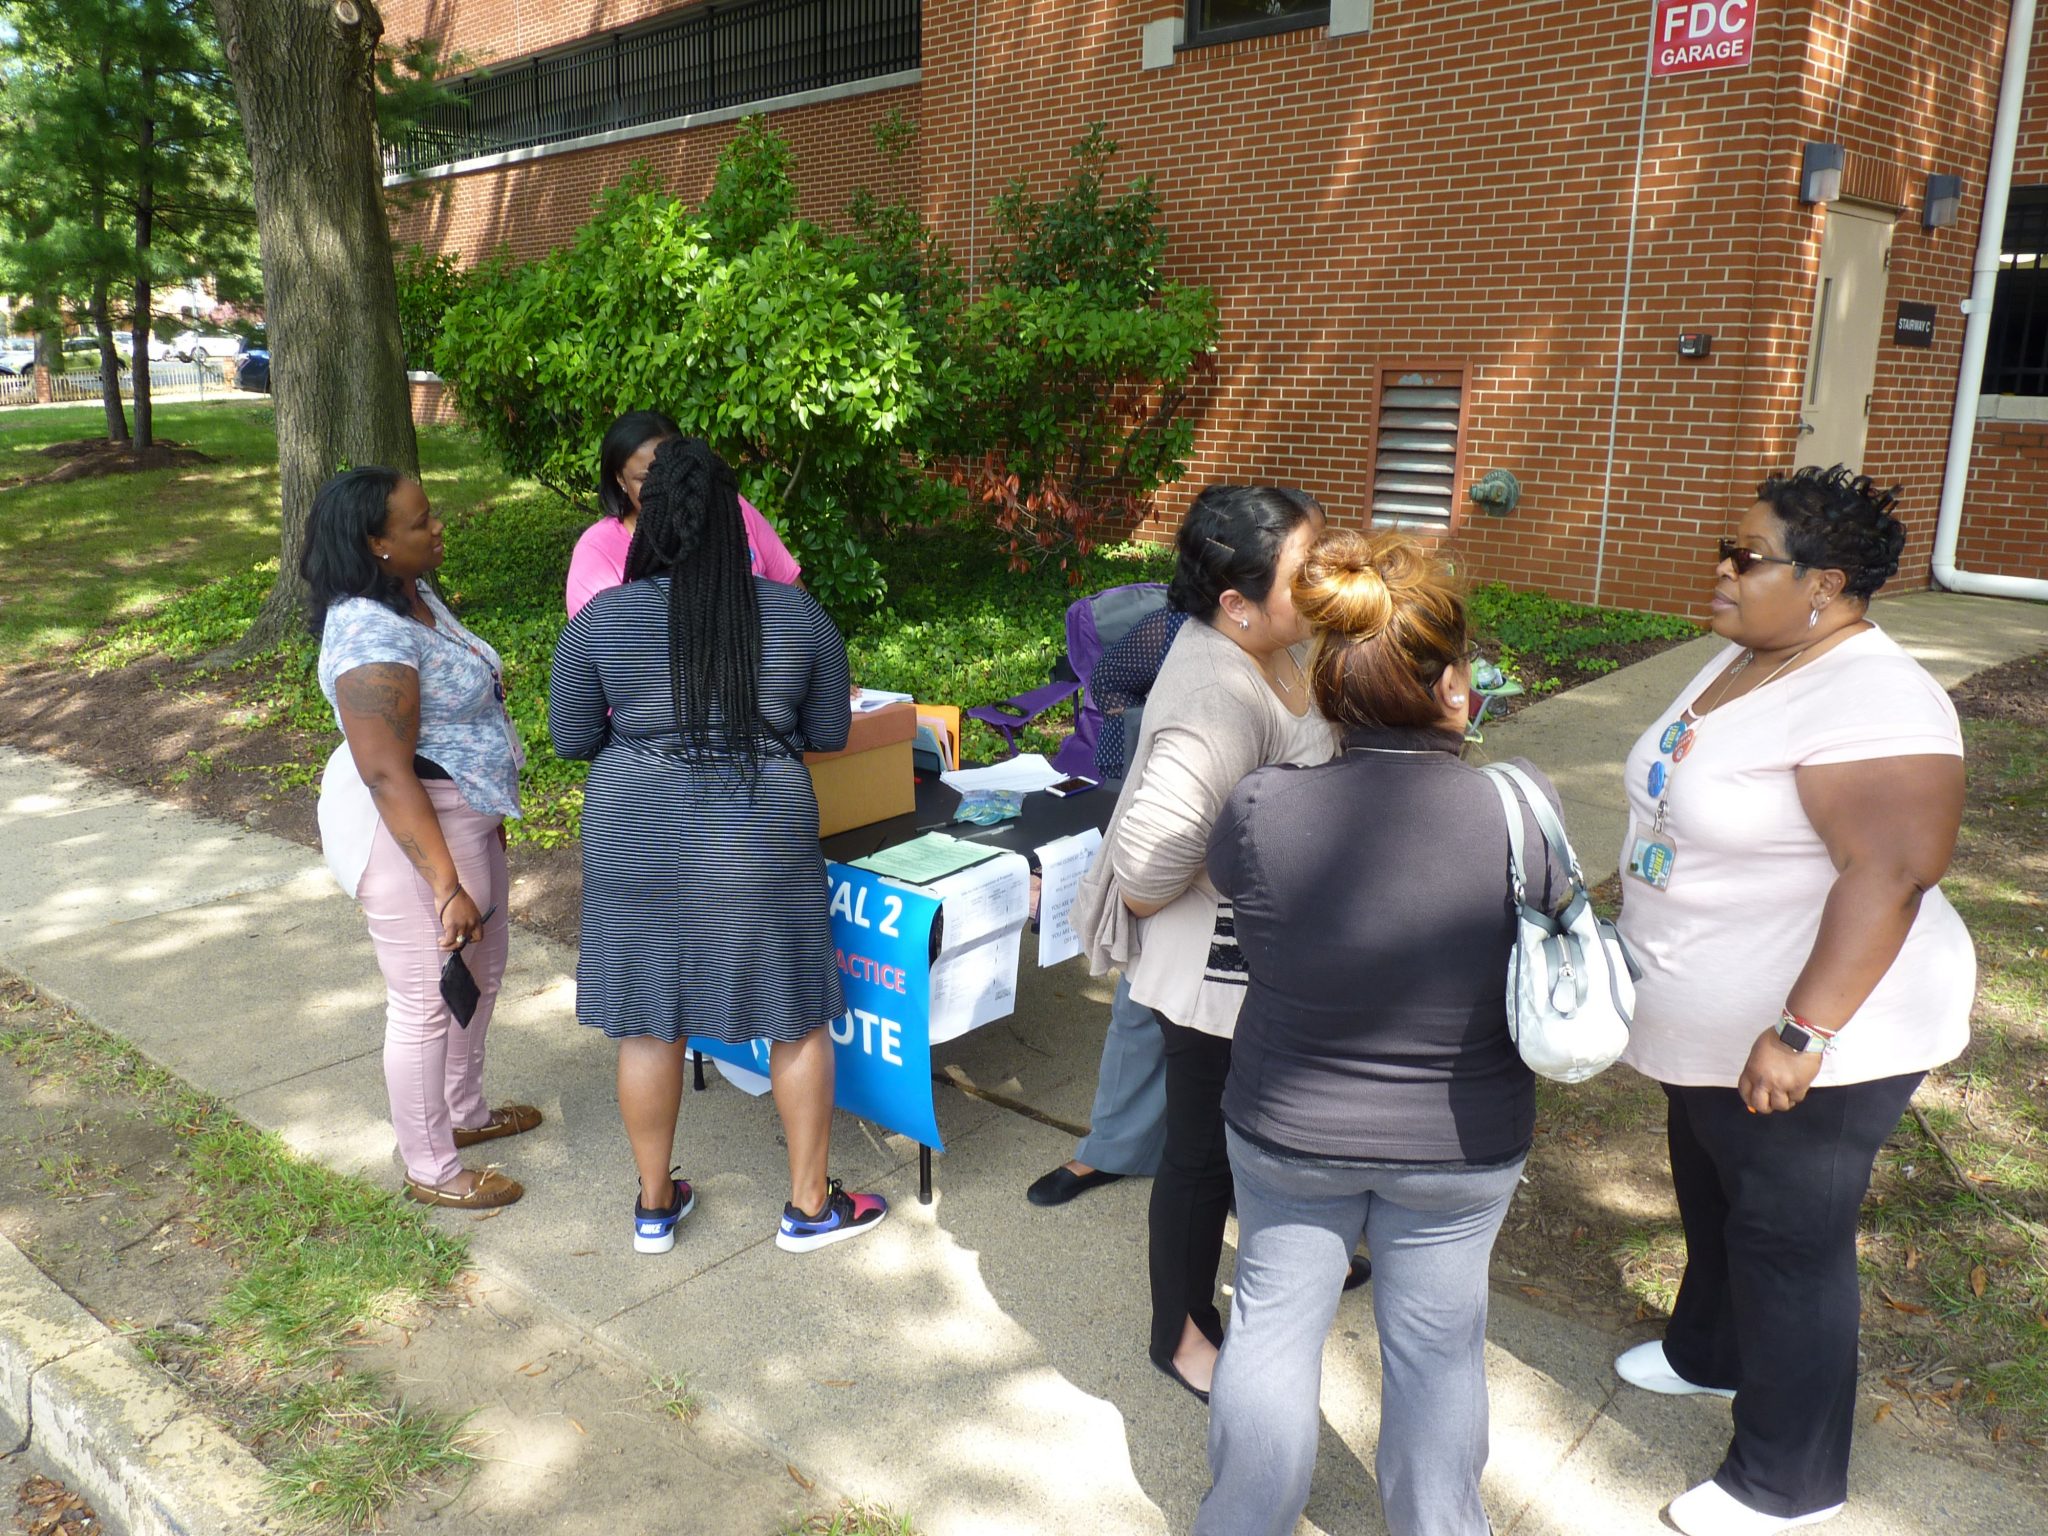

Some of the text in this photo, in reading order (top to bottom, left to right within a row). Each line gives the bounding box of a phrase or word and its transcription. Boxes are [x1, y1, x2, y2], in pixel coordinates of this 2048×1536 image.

[1664, 0, 1747, 42] FDC
[1661, 39, 1744, 66] GARAGE
[1898, 317, 1931, 333] STAIRWAY C
[828, 875, 903, 938] AL 2
[836, 948, 906, 994] ACTICE
[828, 1007, 903, 1067] OTE
[640, 1222, 662, 1235] NIKE
